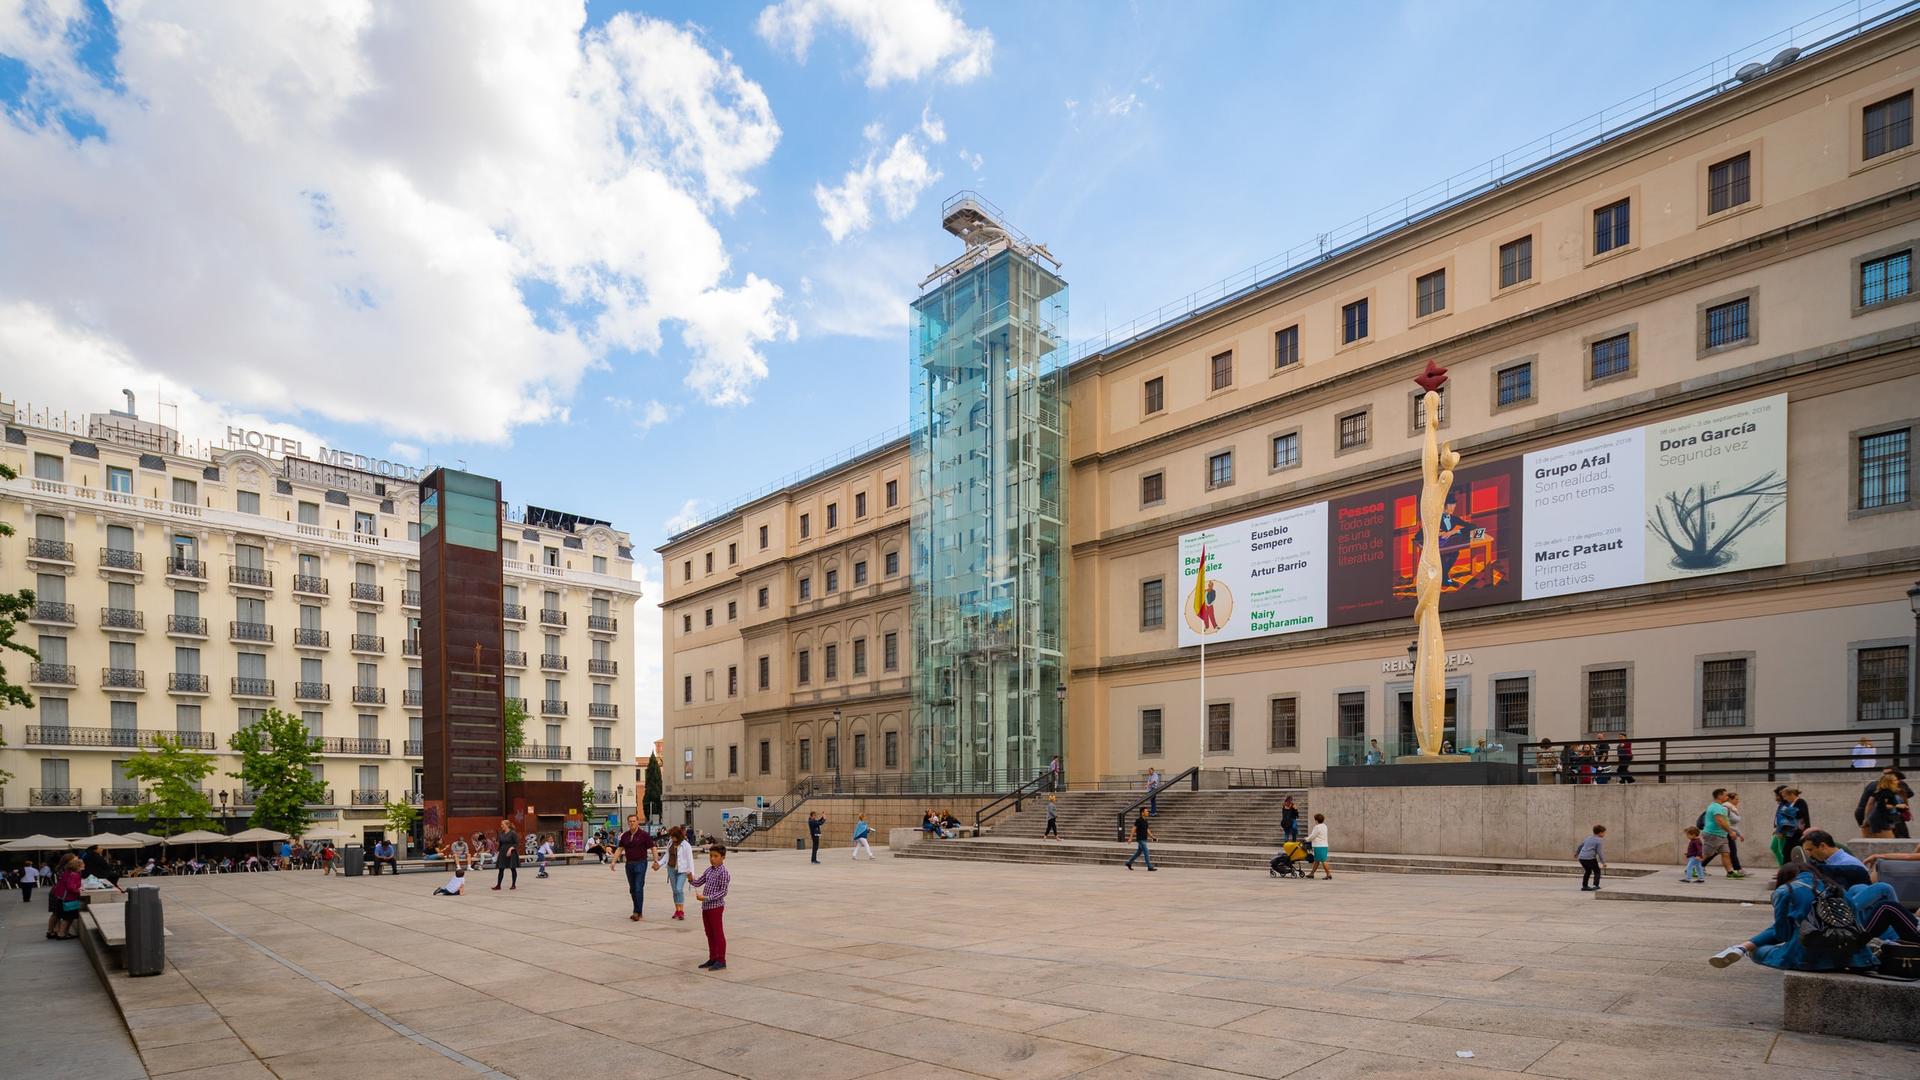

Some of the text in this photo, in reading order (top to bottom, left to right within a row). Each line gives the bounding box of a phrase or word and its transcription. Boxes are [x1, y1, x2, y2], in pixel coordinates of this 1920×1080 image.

[1752, 405, 1772, 414] 2018
[227, 425, 310, 459] HOTEL
[1616, 437, 1632, 446] 2018
[1660, 422, 1756, 452] Dora García
[1660, 440, 1749, 467] Segunda vez
[1535, 452, 1610, 479] Grupo Afal
[1535, 483, 1615, 507] no son temas
[1536, 481, 1558, 494] Son
[1338, 502, 1384, 520] Pessoa
[1338, 514, 1384, 531] Todo arte
[1251, 526, 1288, 540] Eusebio
[1338, 528, 1370, 544] es una
[1606, 527, 1622, 535] 2018
[1251, 537, 1293, 552] Sempere
[1338, 536, 1384, 554] forma de
[1535, 539, 1623, 562] Marc Pataut
[1184, 552, 1216, 566] Beariz
[1338, 550, 1384, 567] literatura
[1184, 562, 1222, 577] Gonález
[1250, 560, 1308, 578] Artur Barrio
[1535, 560, 1587, 576] Primeras
[1534, 574, 1596, 590] tentativas
[1251, 610, 1276, 620] Nairy
[1251, 616, 1314, 631] Bagharamian
[1382, 658, 1414, 673] REIN
